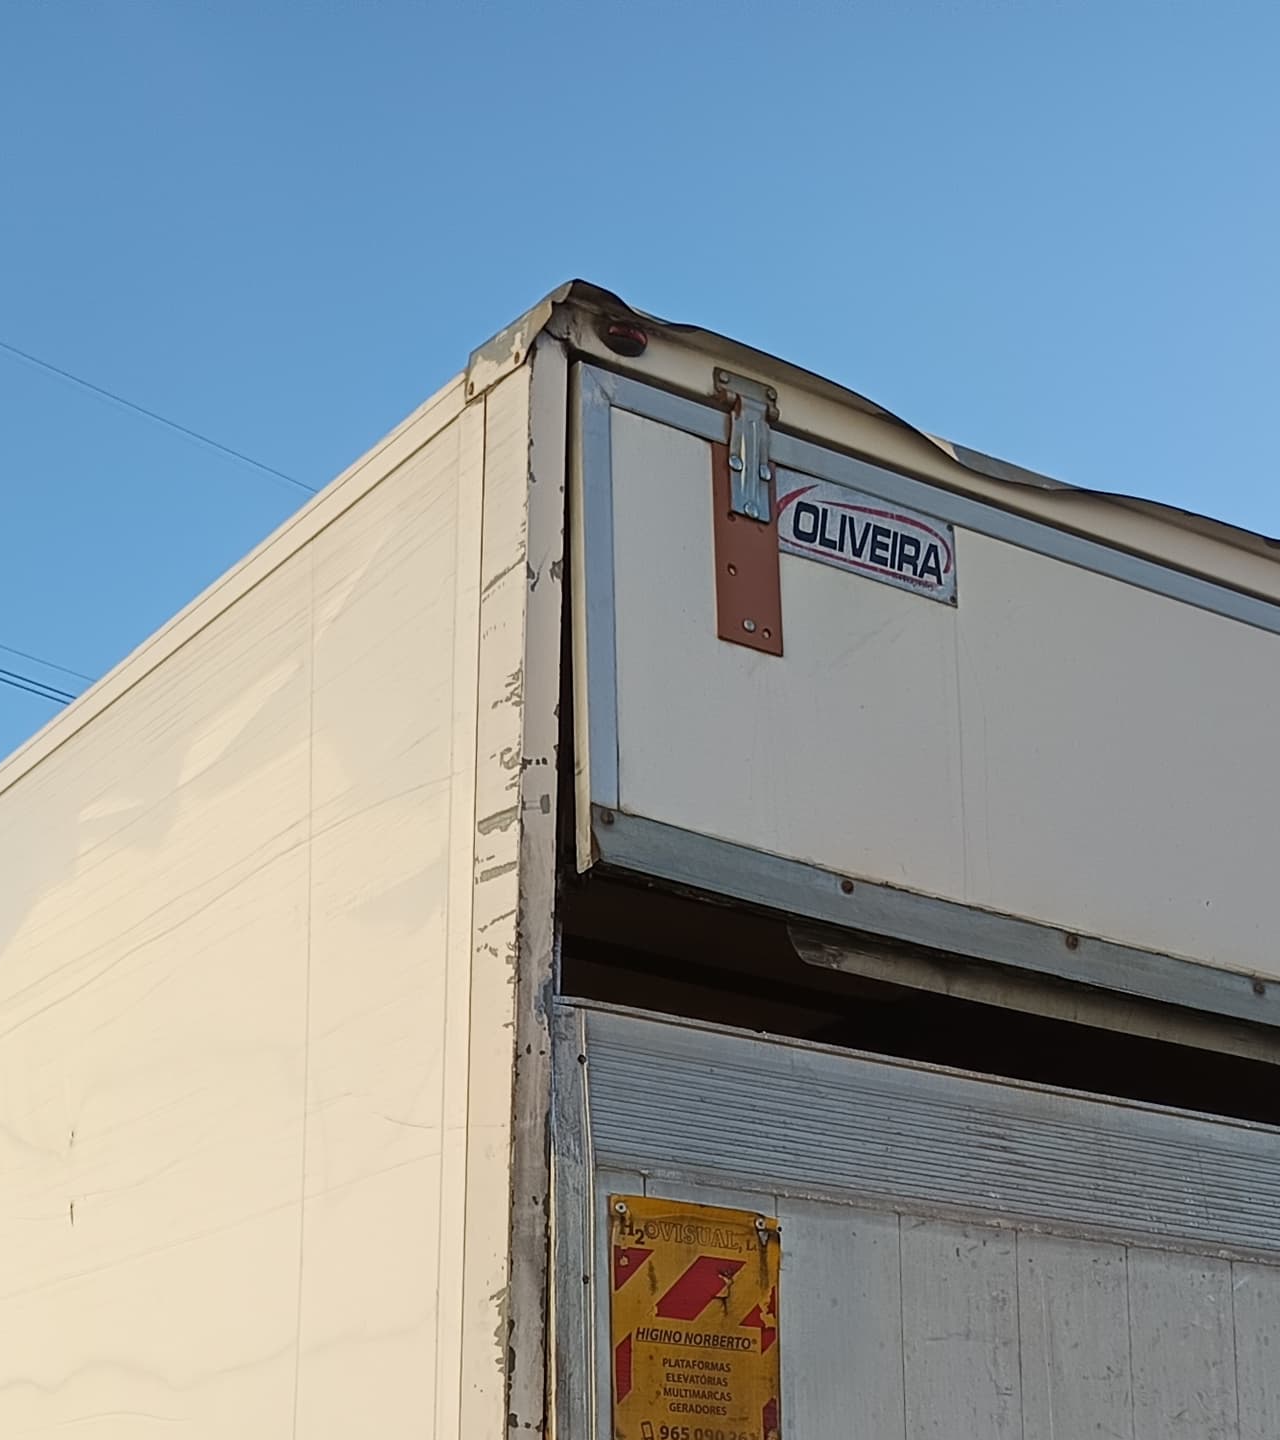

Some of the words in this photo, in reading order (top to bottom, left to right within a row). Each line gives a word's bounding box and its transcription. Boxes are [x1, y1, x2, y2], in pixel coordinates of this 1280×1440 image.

[793, 501, 943, 585] OLIVEIRA
[636, 1327, 682, 1343] HIGINO
[662, 1358, 731, 1373] PLATAFORMAS
[666, 1372, 728, 1387] ELEVATÓRIAS
[664, 1387, 732, 1402] MULTIMARCAS
[669, 1402, 727, 1416] GERADORES
